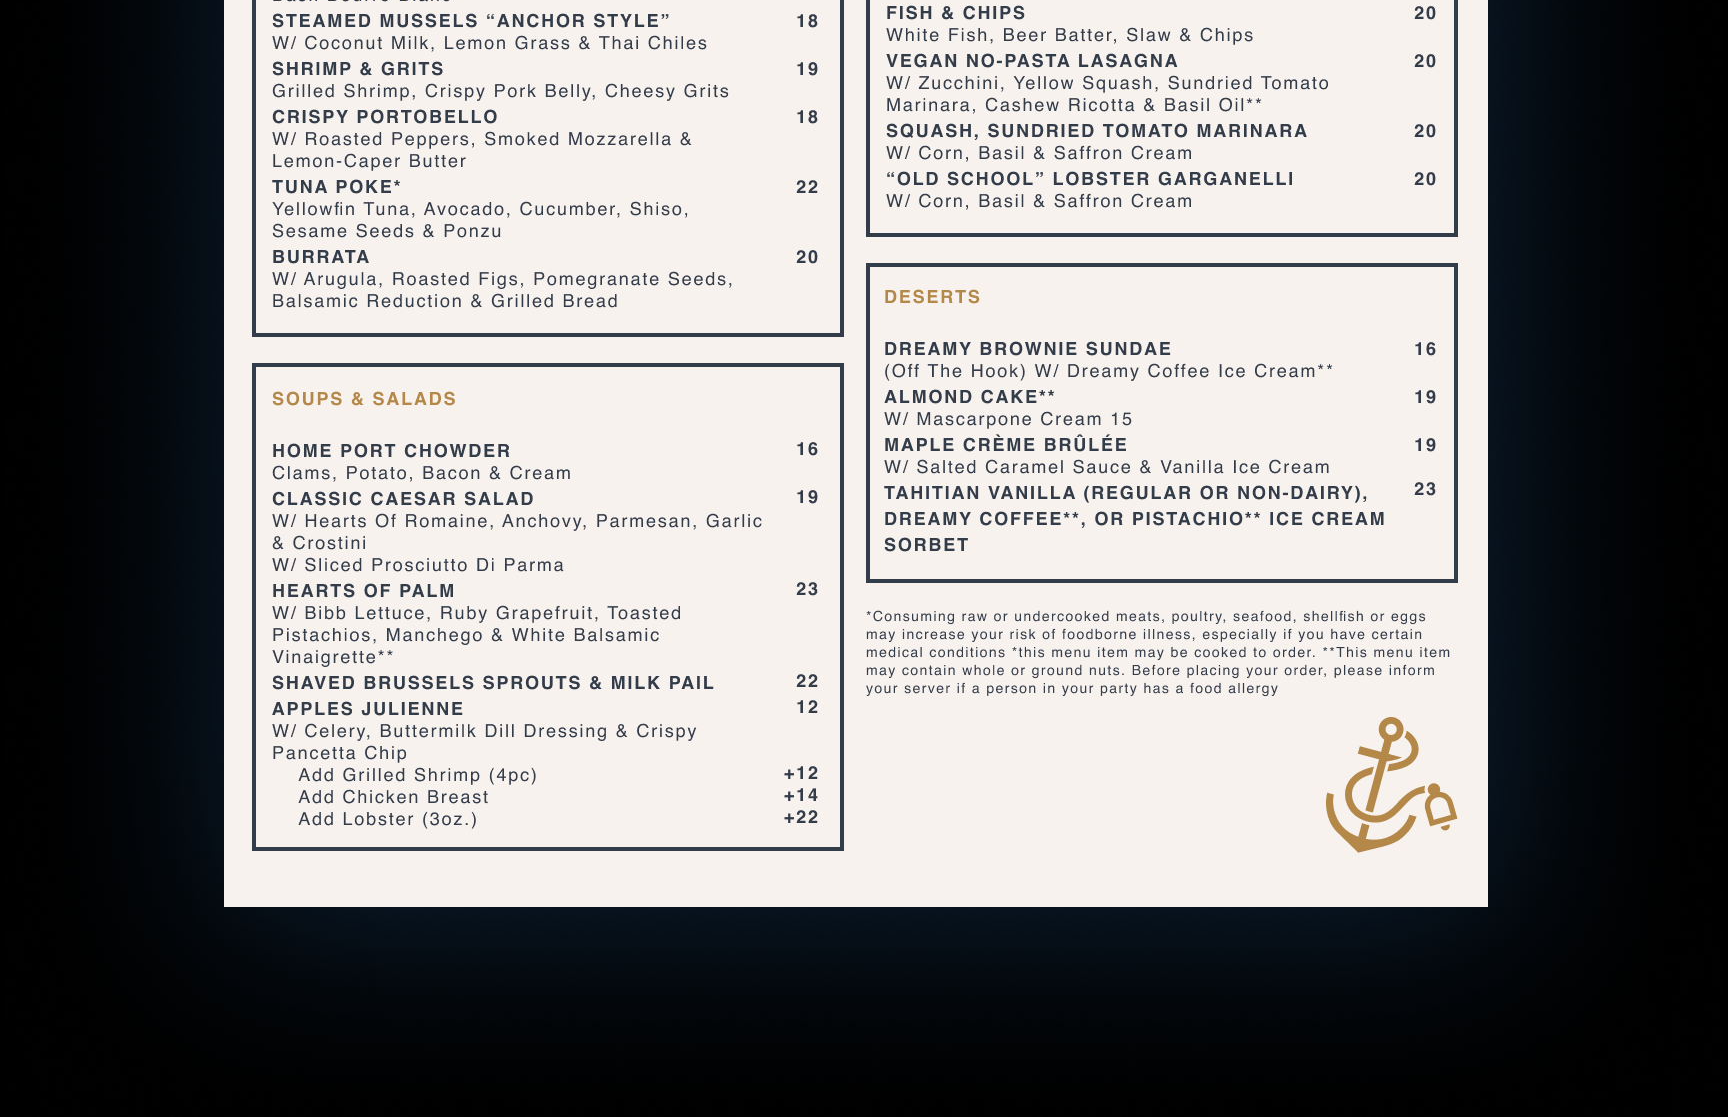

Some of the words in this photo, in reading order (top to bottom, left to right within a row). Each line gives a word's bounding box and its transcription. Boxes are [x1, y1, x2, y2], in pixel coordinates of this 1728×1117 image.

[272, 12, 371, 29] STEAMED
[379, 12, 478, 29] MUSSELS
[796, 13, 819, 29] 18
[272, 108, 349, 125] CRISPY
[356, 108, 498, 125] PORTOBELLO
[796, 109, 819, 125] 18
[1053, 170, 1150, 187] LOBSTER
[1157, 170, 1293, 187] GARGANELLI
[1413, 171, 1437, 187] 20
[272, 249, 370, 265] BURRATA
[795, 249, 819, 265] 20
[272, 293, 358, 309] Balsamic
[367, 293, 462, 309] Reduction
[470, 293, 483, 309] &
[491, 292, 554, 309] Grilled
[563, 293, 618, 309] Bread
[884, 288, 980, 305] DESERTS
[884, 341, 972, 356] DREAMY
[979, 340, 1078, 357] BROWNIE
[1085, 340, 1171, 357] SUNDAE
[1414, 341, 1437, 357] 16
[272, 390, 343, 407] SOUPS
[351, 391, 364, 406] &
[372, 390, 456, 407] SALADS
[883, 388, 973, 405] ALMOND
[1414, 389, 1437, 405] 19
[272, 442, 332, 459] HOME
[340, 442, 397, 459] PORT
[404, 442, 510, 459] CHOWDER
[796, 441, 819, 457] 16
[884, 437, 955, 452] MAPLE
[962, 433, 1036, 453] CRÈME
[1044, 433, 1127, 453] BRÛLÉE
[1414, 437, 1437, 453] 19
[271, 513, 297, 528] W/
[305, 513, 367, 529] Hearts
[374, 512, 397, 529] Of
[405, 513, 494, 531] Romaine,
[501, 513, 587, 532] Anchovy,
[596, 513, 697, 531] Parmesan,
[705, 512, 763, 529] Garlic
[272, 582, 356, 599] HEARTS
[363, 582, 391, 599] OF
[399, 583, 454, 598] PALM
[795, 581, 819, 597] 23
[961, 612, 988, 623] raw
[993, 612, 1009, 623] or
[1014, 610, 1110, 623] undercooked
[1116, 610, 1165, 624] meats,
[1171, 610, 1226, 625] poultry,
[1232, 610, 1297, 624] seafood,
[1303, 610, 1364, 623] shellfish
[1370, 612, 1385, 623] or
[1390, 612, 1426, 625] eggs
[865, 684, 899, 697] your
[903, 684, 951, 695] server
[956, 682, 966, 694] if
[971, 684, 981, 695] a
[986, 684, 1037, 697] person
[1042, 682, 1056, 694] in
[1061, 684, 1094, 697] your
[1100, 682, 1138, 697] party
[1143, 682, 1170, 695] has
[1175, 684, 1184, 695] a
[1189, 682, 1222, 695] food
[1228, 682, 1279, 697] allergy
[271, 700, 353, 717] APPLES
[360, 701, 464, 717] JULIENNE
[796, 699, 819, 714] 12
[297, 767, 334, 783] Add
[342, 766, 406, 783] Grilled
[414, 766, 481, 786] Shrimp
[489, 767, 537, 786] (4pc)
[783, 765, 819, 780] +12
[297, 811, 334, 827] Add
[343, 811, 414, 827] Lobster
[422, 811, 477, 830] (3oz.)
[783, 809, 819, 824] +22
